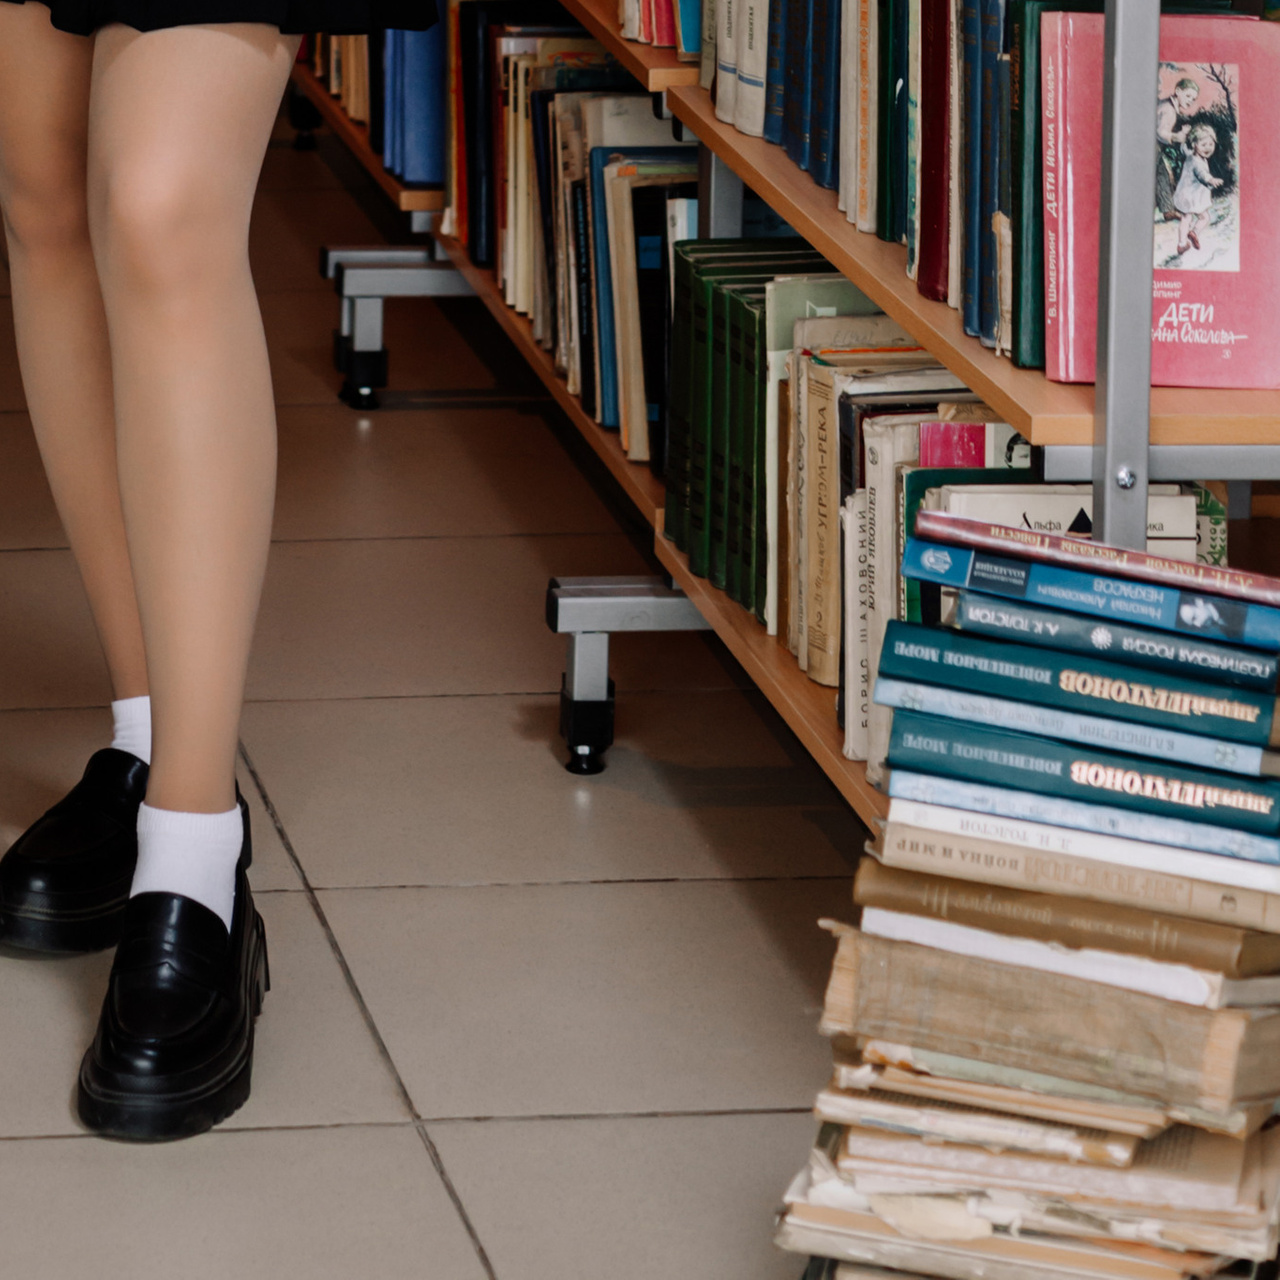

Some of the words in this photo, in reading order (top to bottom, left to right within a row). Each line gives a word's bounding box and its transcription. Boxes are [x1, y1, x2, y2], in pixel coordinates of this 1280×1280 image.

[1044, 170, 1057, 218] ДЕТИ
[1046, 228, 1058, 302] ШМЕРЛИНГ
[1153, 280, 1182, 290] ДИМИР
[1158, 302, 1215, 328] ДЕТИ
[1152, 326, 1179, 343] АНА
[866, 485, 877, 559] ЯКОВЛЕВ
[866, 562, 876, 611] ЮРИЙ
[1093, 577, 1165, 604] НЕКРАСОВ
[968, 606, 1030, 632] ТОЛСТОЙ
[893, 640, 941, 663] МОРЕ
[1121, 636, 1175, 660] РОССИЯ
[902, 733, 948, 756] МОРЕ
[896, 838, 938, 858] МИР
[959, 850, 1020, 871] ВОЙНА
